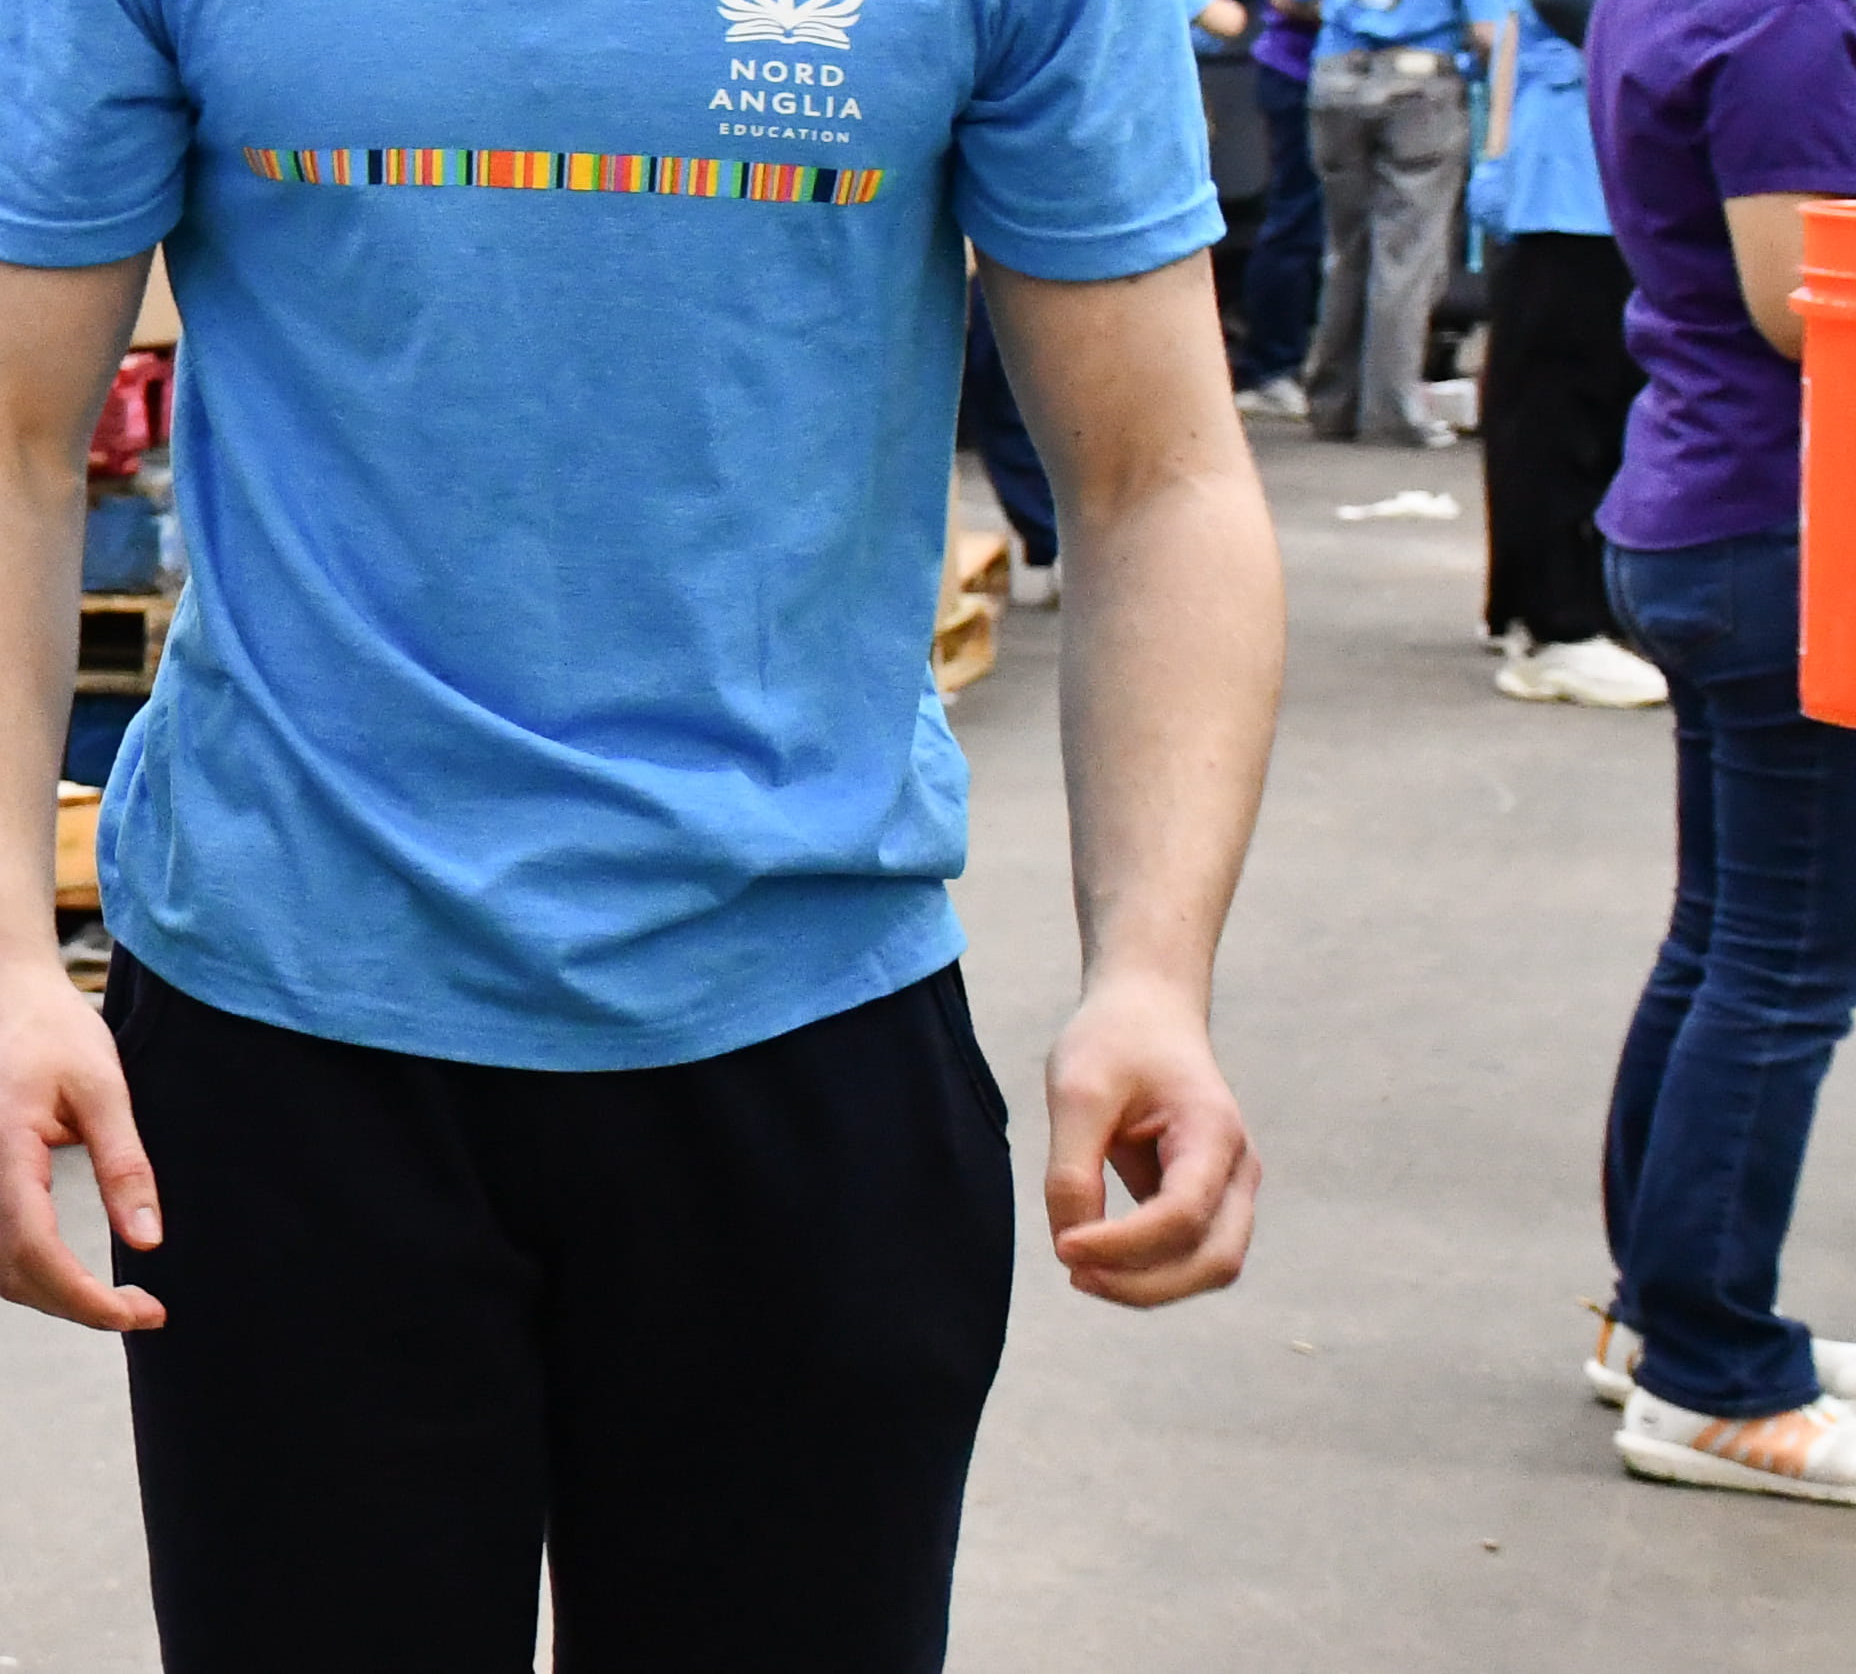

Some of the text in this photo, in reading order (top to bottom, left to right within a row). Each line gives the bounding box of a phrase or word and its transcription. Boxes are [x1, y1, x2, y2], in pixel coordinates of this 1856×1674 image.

[730, 59, 845, 88] NORD
[708, 89, 862, 120] ANGLIA
[719, 123, 850, 143] EDUCATION
